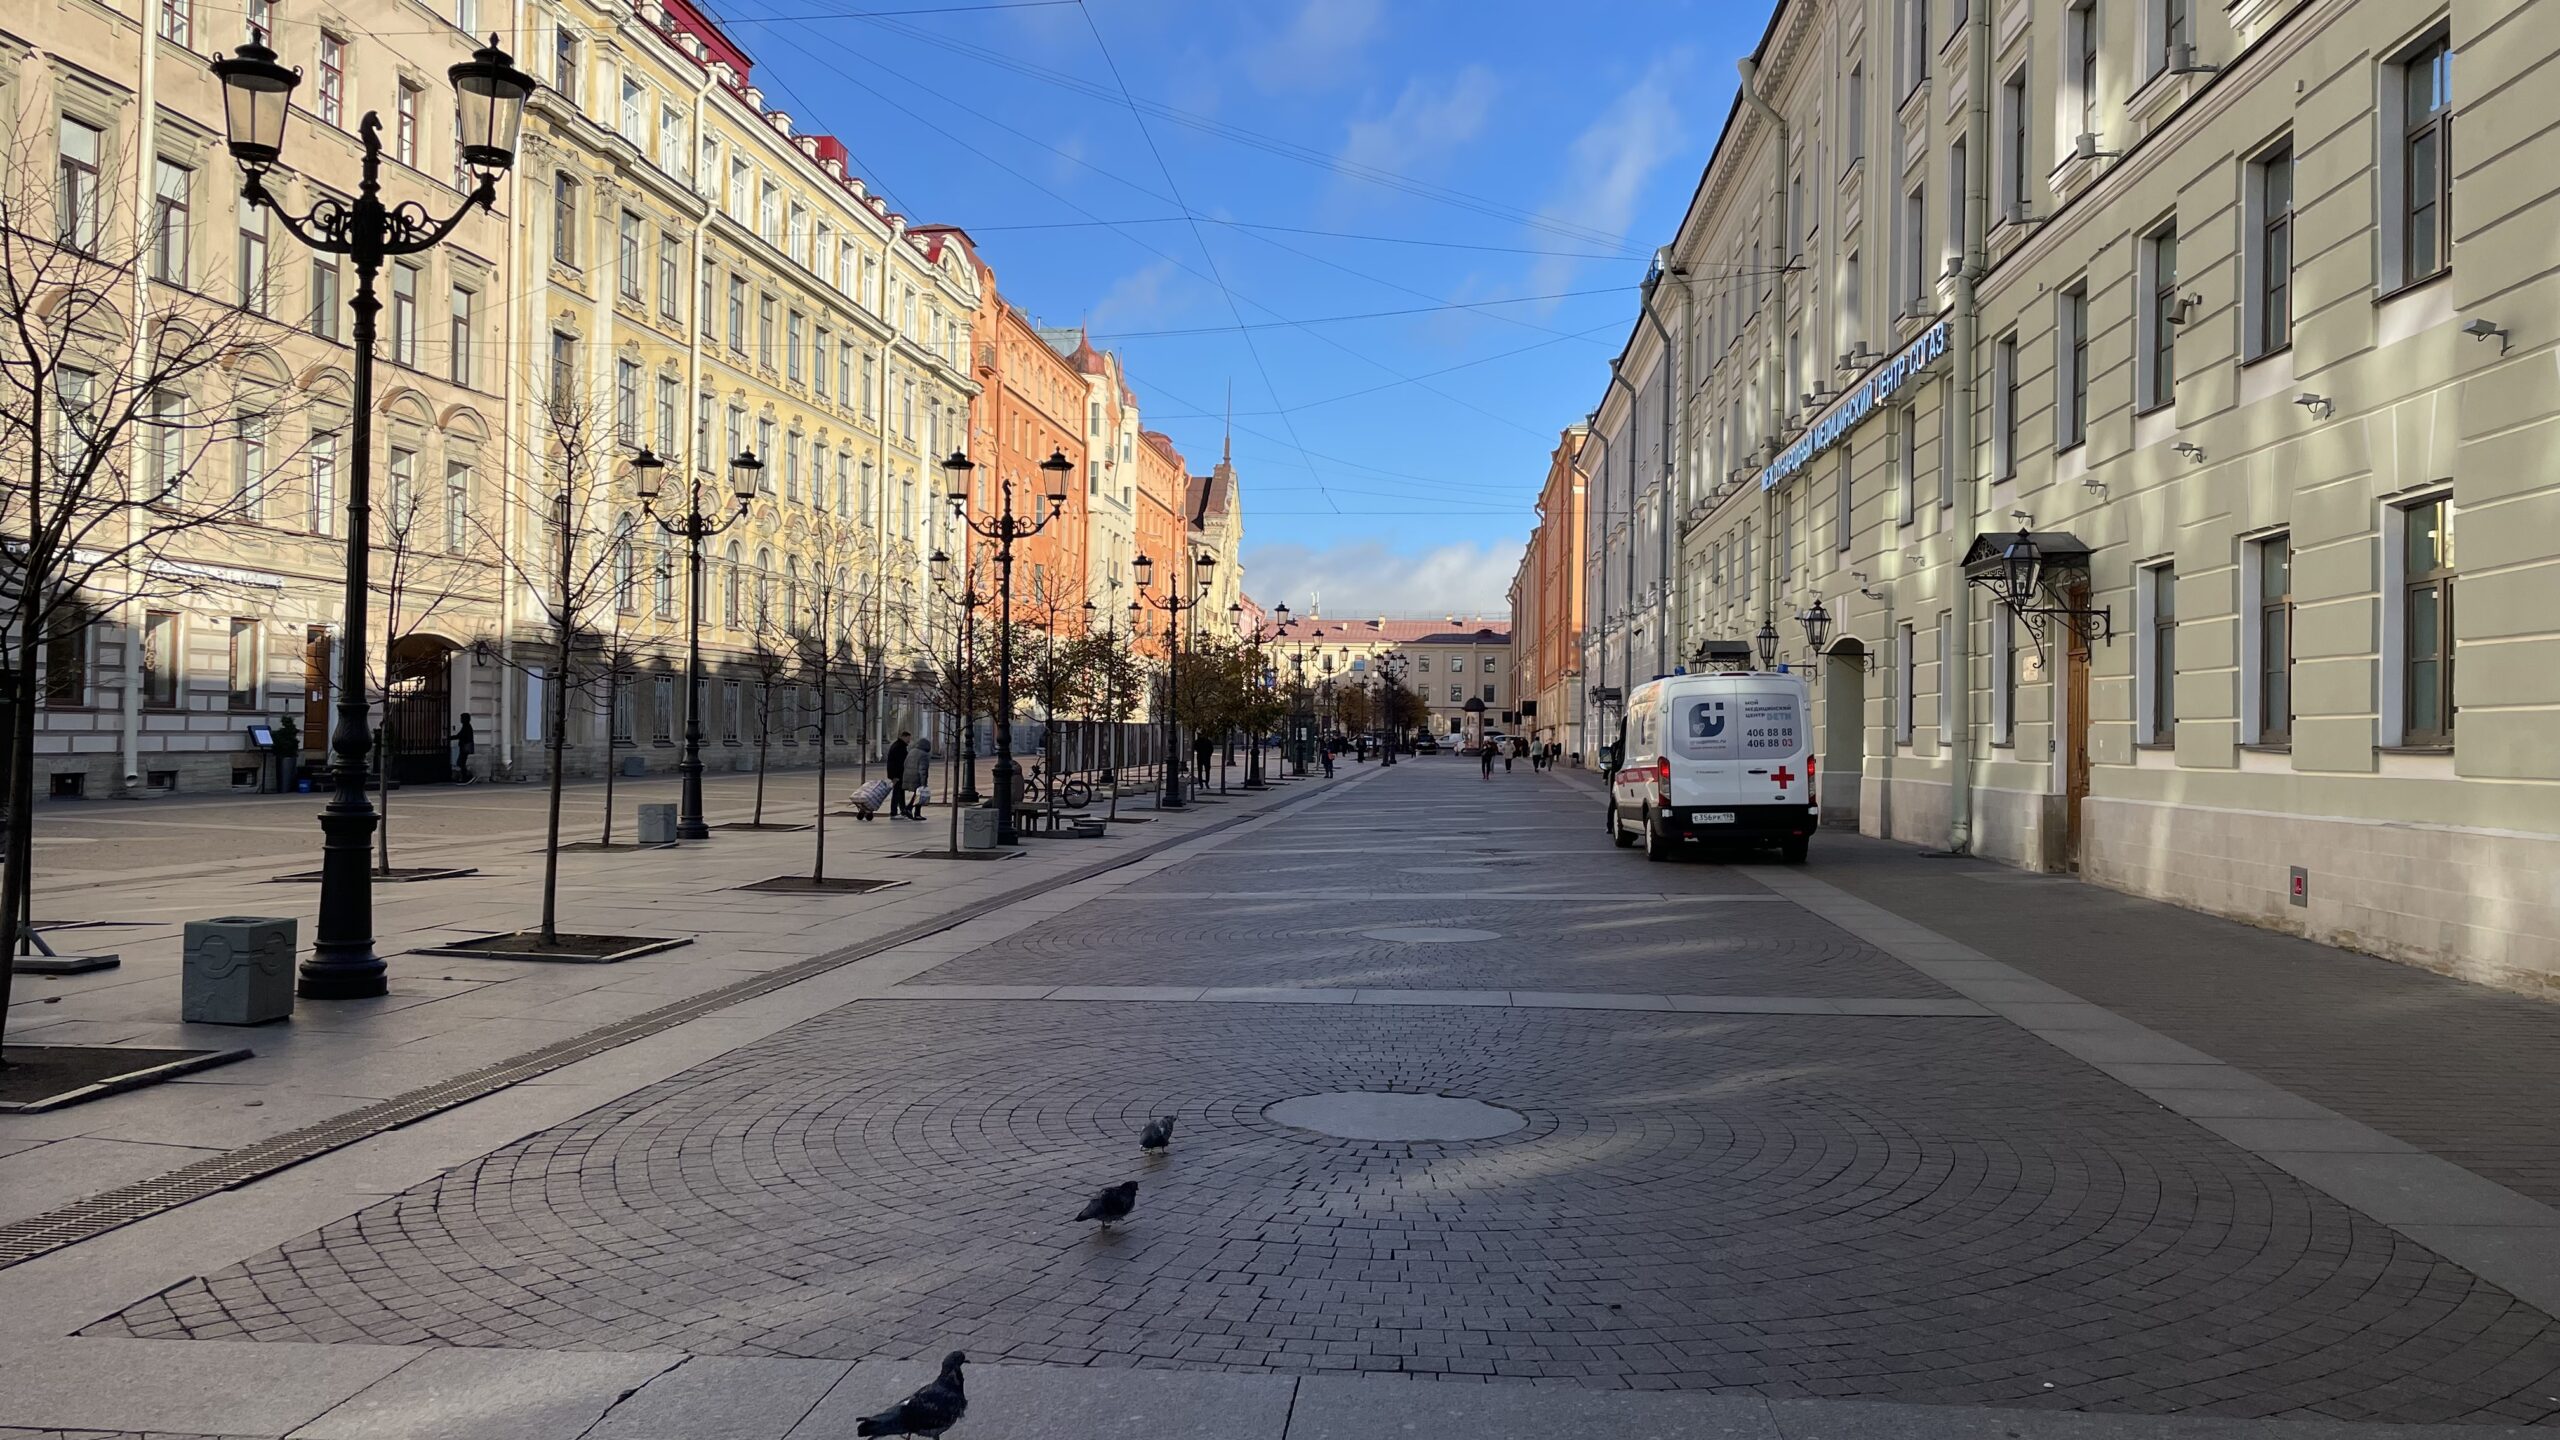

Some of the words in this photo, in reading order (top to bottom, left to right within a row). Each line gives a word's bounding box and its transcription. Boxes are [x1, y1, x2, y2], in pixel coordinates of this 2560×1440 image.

[1761, 430, 1812, 492] МЕЖДУНАРОДНЫЙ
[1814, 380, 1873, 452] МЕДИЦИНСКИЙ
[1874, 355, 1905, 407] ЦЕНТР
[1909, 321, 1944, 374] СОГАЗ
[1746, 728, 1764, 737] 406
[1767, 728, 1779, 737] 88
[1781, 727, 1793, 737] 88
[1747, 738, 1765, 748] 406
[1767, 738, 1780, 748] 88
[1781, 738, 1793, 747] 03
